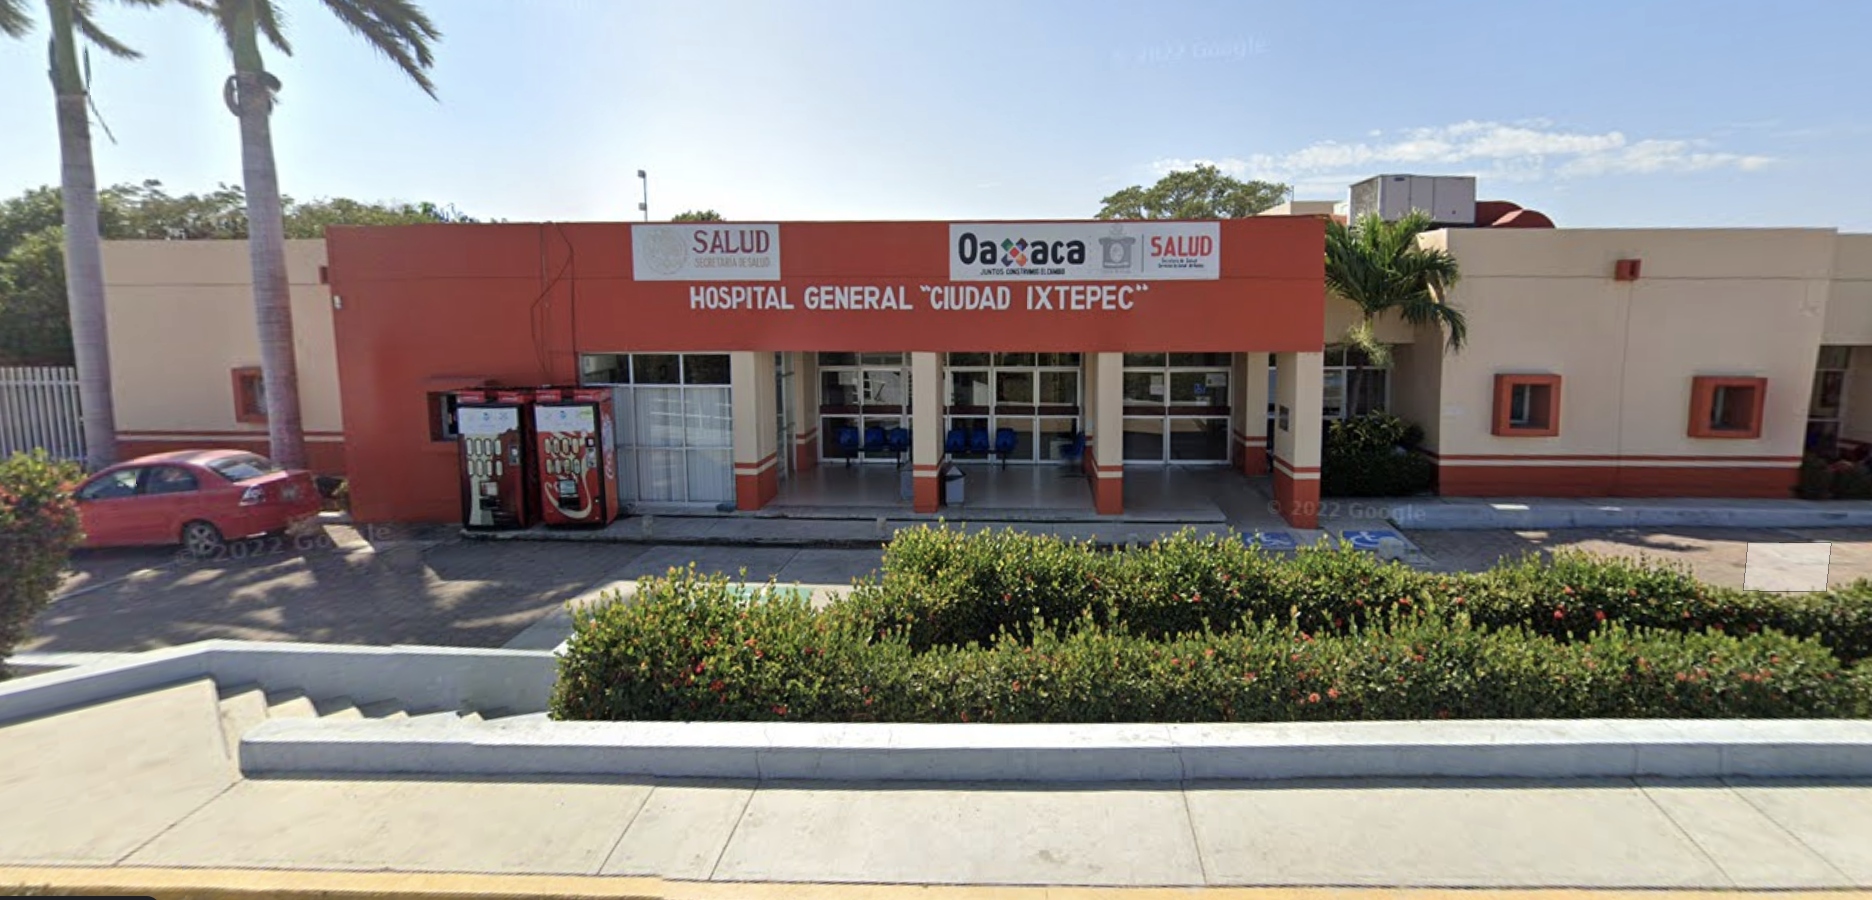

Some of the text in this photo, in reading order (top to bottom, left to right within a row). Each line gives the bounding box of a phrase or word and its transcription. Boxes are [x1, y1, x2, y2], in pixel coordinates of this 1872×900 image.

[692, 229, 770, 254] SALUD
[958, 232, 1086, 267] Oaxaca
[1150, 235, 1213, 257] SALUD
[748, 257, 771, 268] SALUD
[980, 268, 1005, 276] JUNTOS
[690, 286, 795, 310] HOSPITAL
[804, 286, 914, 310] GENERAL
